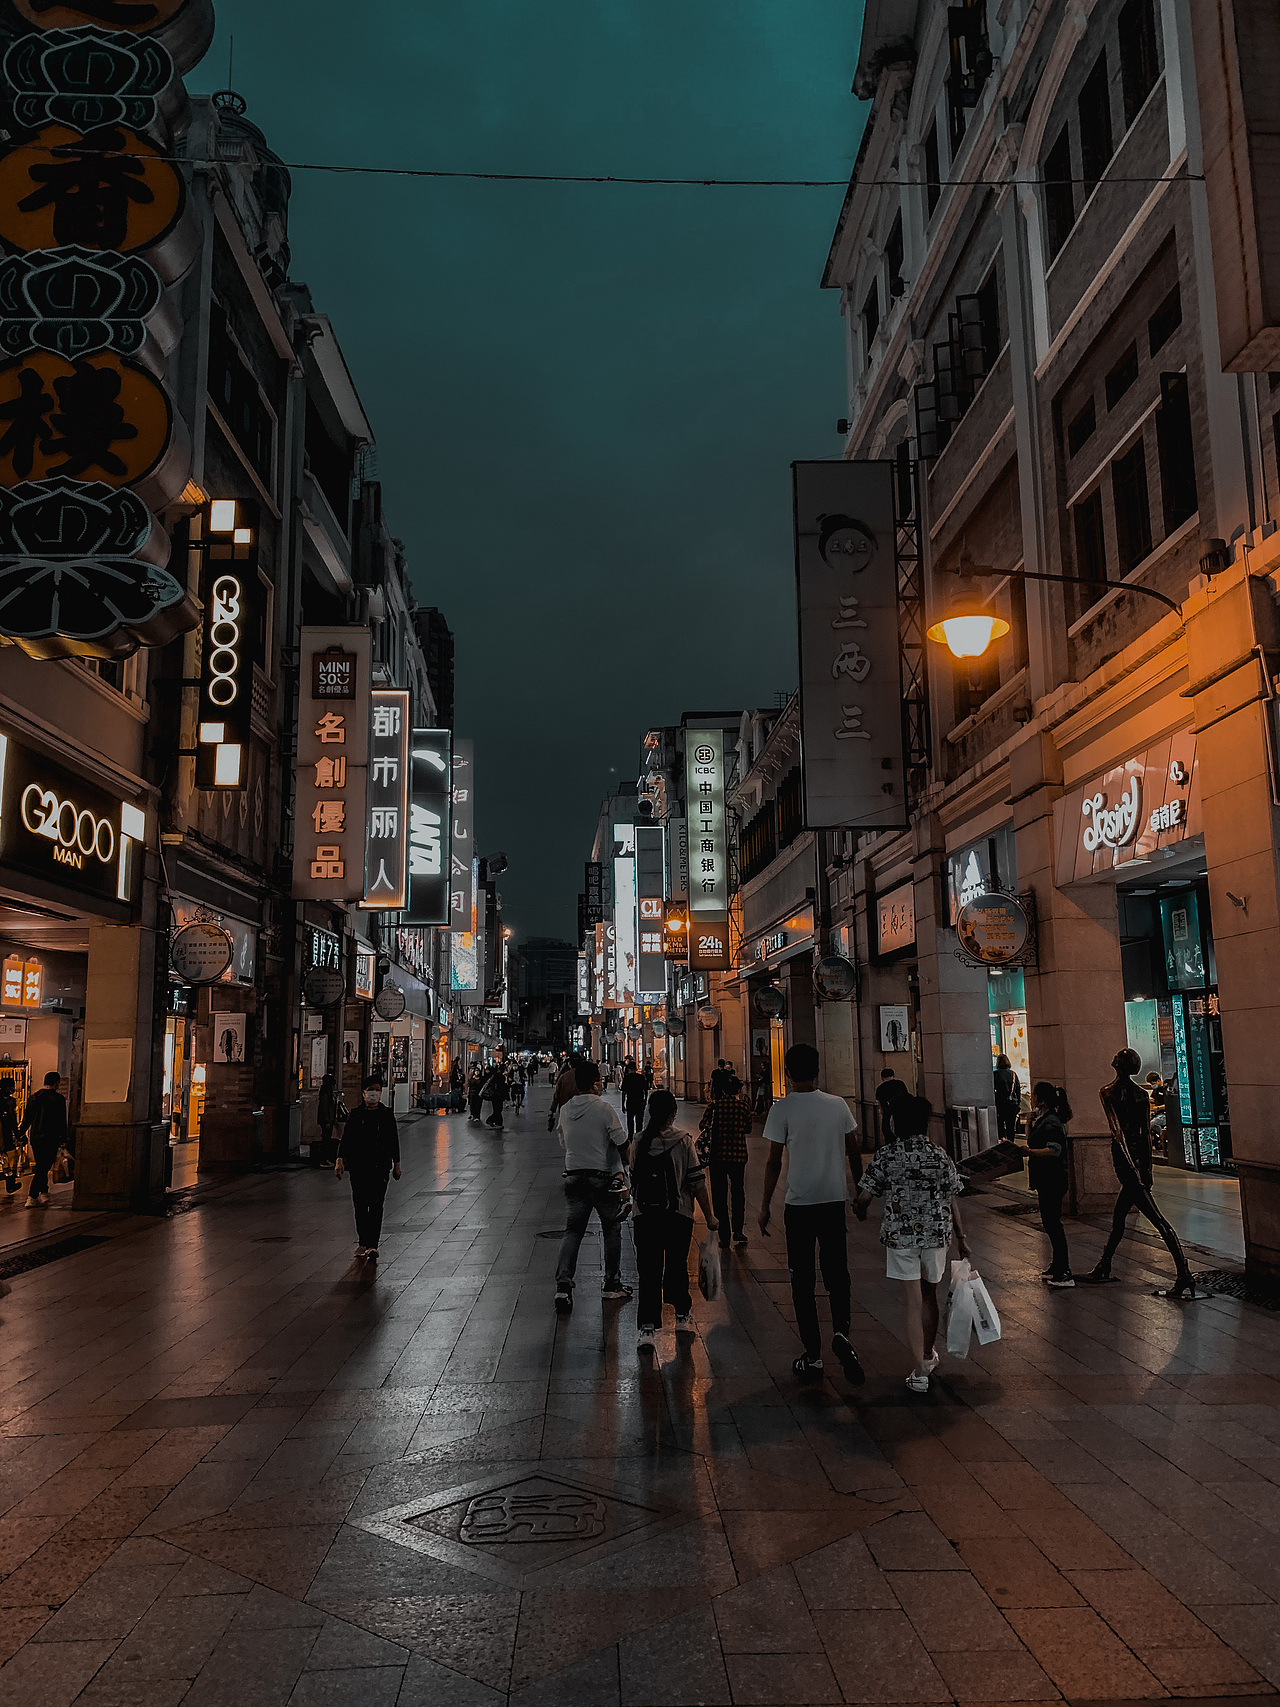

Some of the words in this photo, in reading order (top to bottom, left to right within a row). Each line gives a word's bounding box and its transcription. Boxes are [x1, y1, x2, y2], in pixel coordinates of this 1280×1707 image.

[208, 575, 241, 706] G2000
[319, 661, 350, 673] MINI
[21, 783, 115, 863] G2000
[311, 712, 346, 879] 名創優品
[370, 705, 400, 891] 都市丽人
[53, 845, 82, 870] MAN
[410, 803, 441, 875] ANTA
[699, 780, 716, 893] 中国工商银行
[641, 900, 661, 914] CL
[699, 935, 723, 949] 24h
